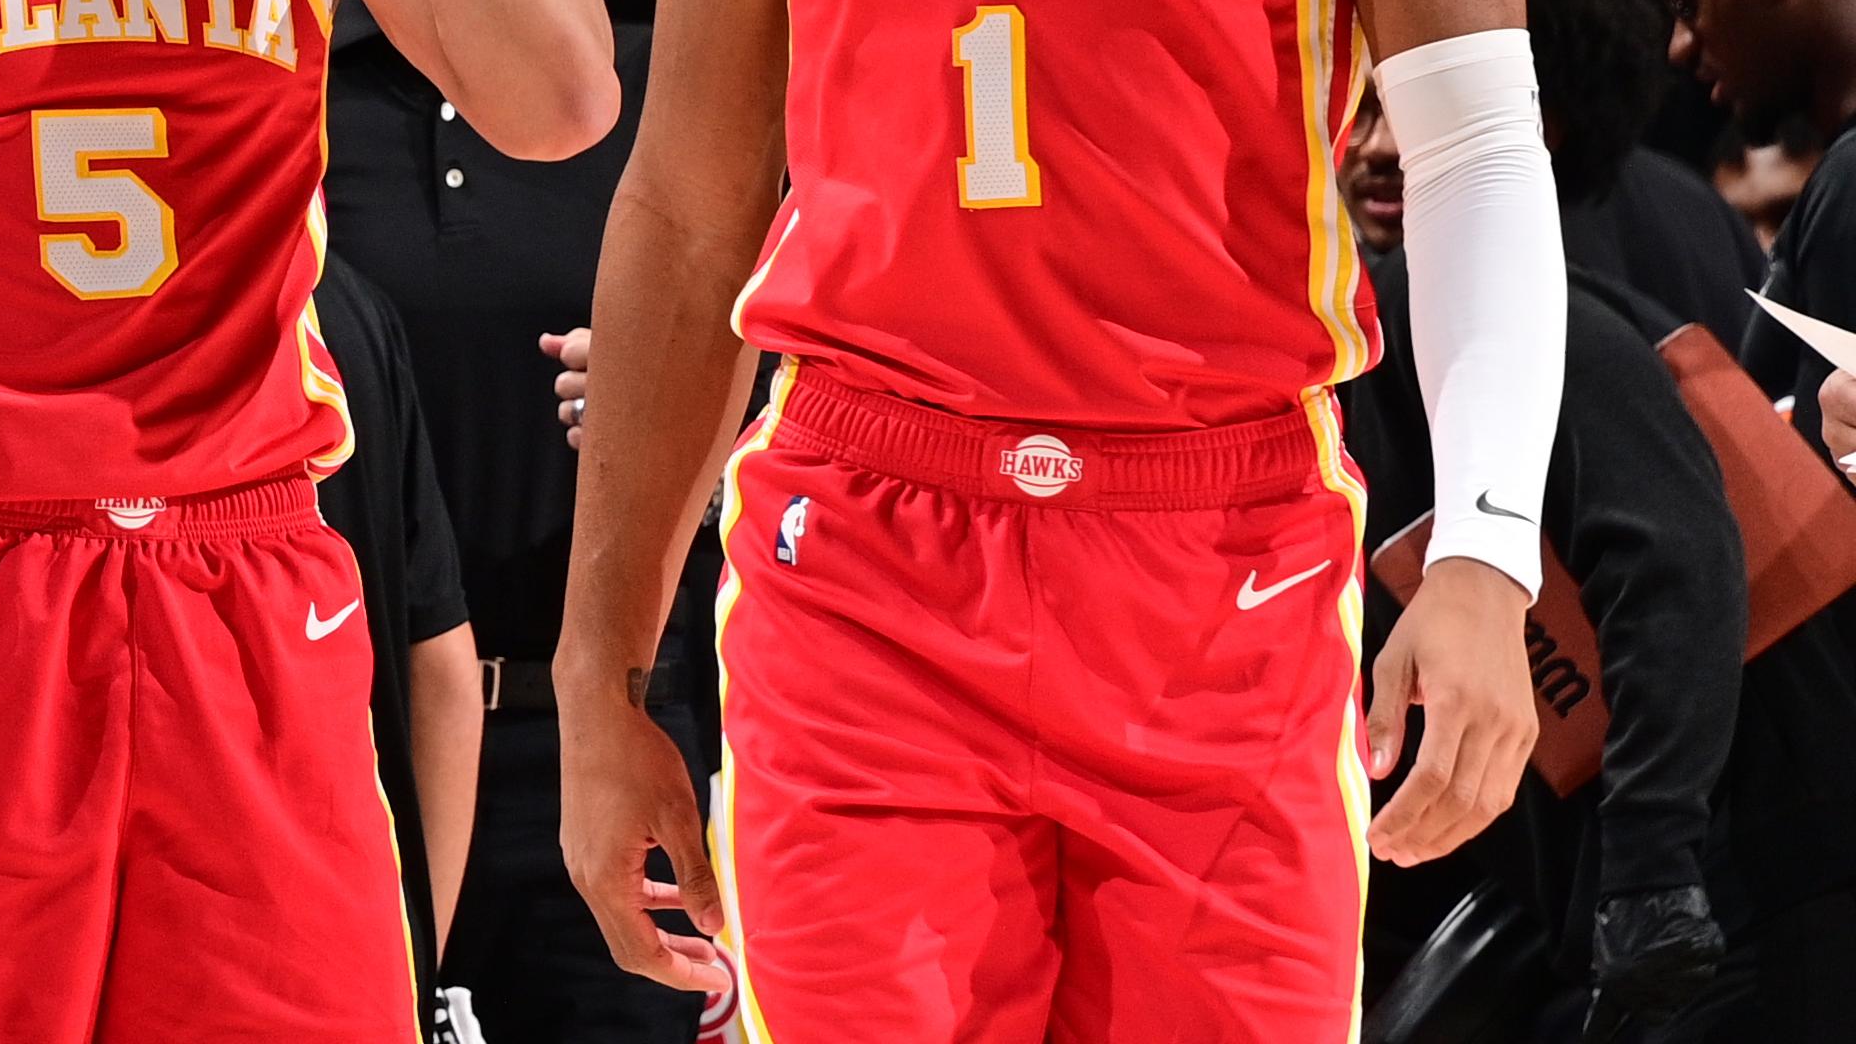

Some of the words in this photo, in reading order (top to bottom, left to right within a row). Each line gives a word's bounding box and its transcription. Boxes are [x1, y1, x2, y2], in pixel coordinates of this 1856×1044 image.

[30, 106, 180, 301] 5
[951, 4, 1042, 210] 1
[1003, 452, 1081, 480] HAWKS
